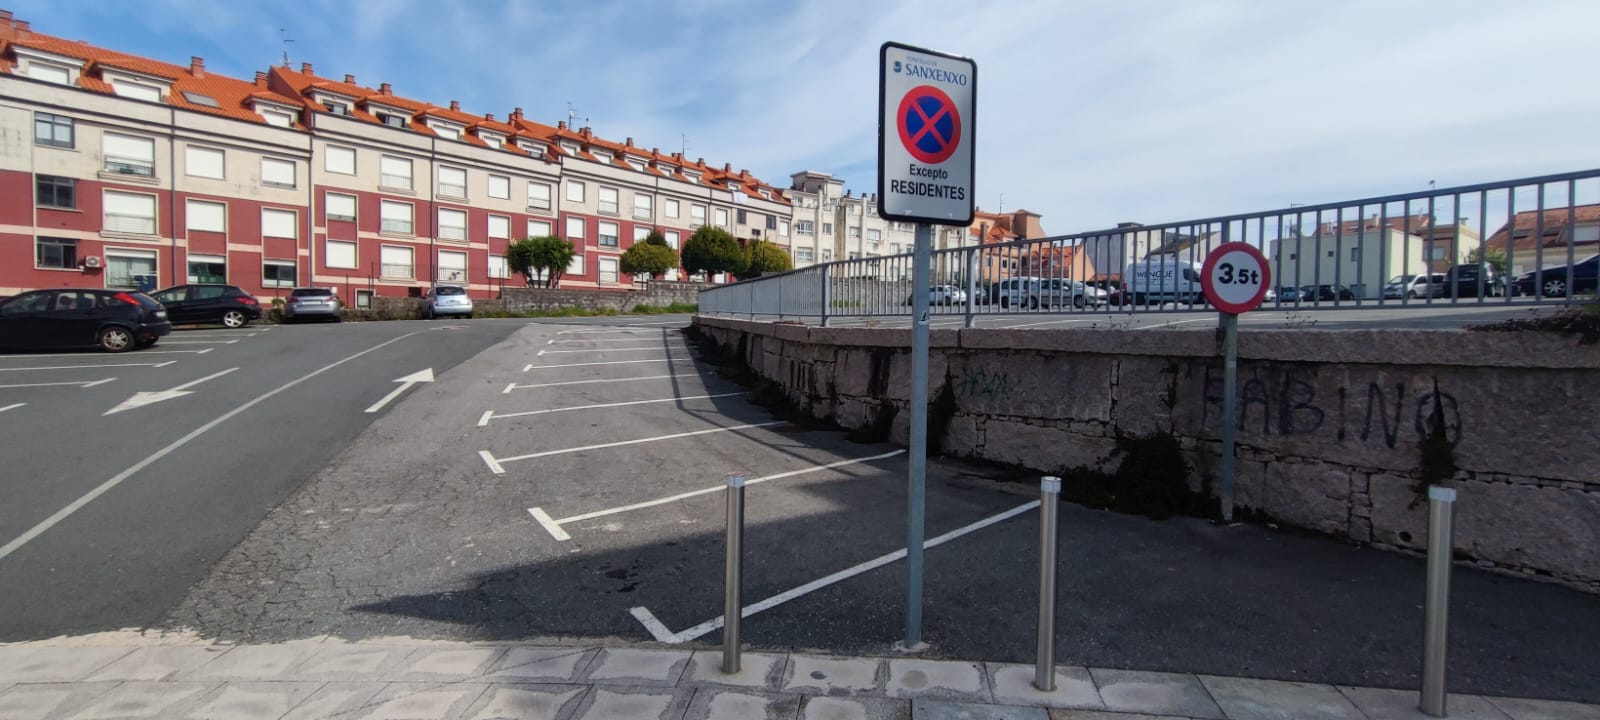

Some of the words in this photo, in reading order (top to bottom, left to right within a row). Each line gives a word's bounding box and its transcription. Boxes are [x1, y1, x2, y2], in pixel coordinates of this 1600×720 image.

[905, 63, 967, 86] SANXENXO
[909, 163, 948, 180] Excepto
[891, 179, 965, 201] RESIDENTES
[1218, 262, 1259, 285] 3.5t
